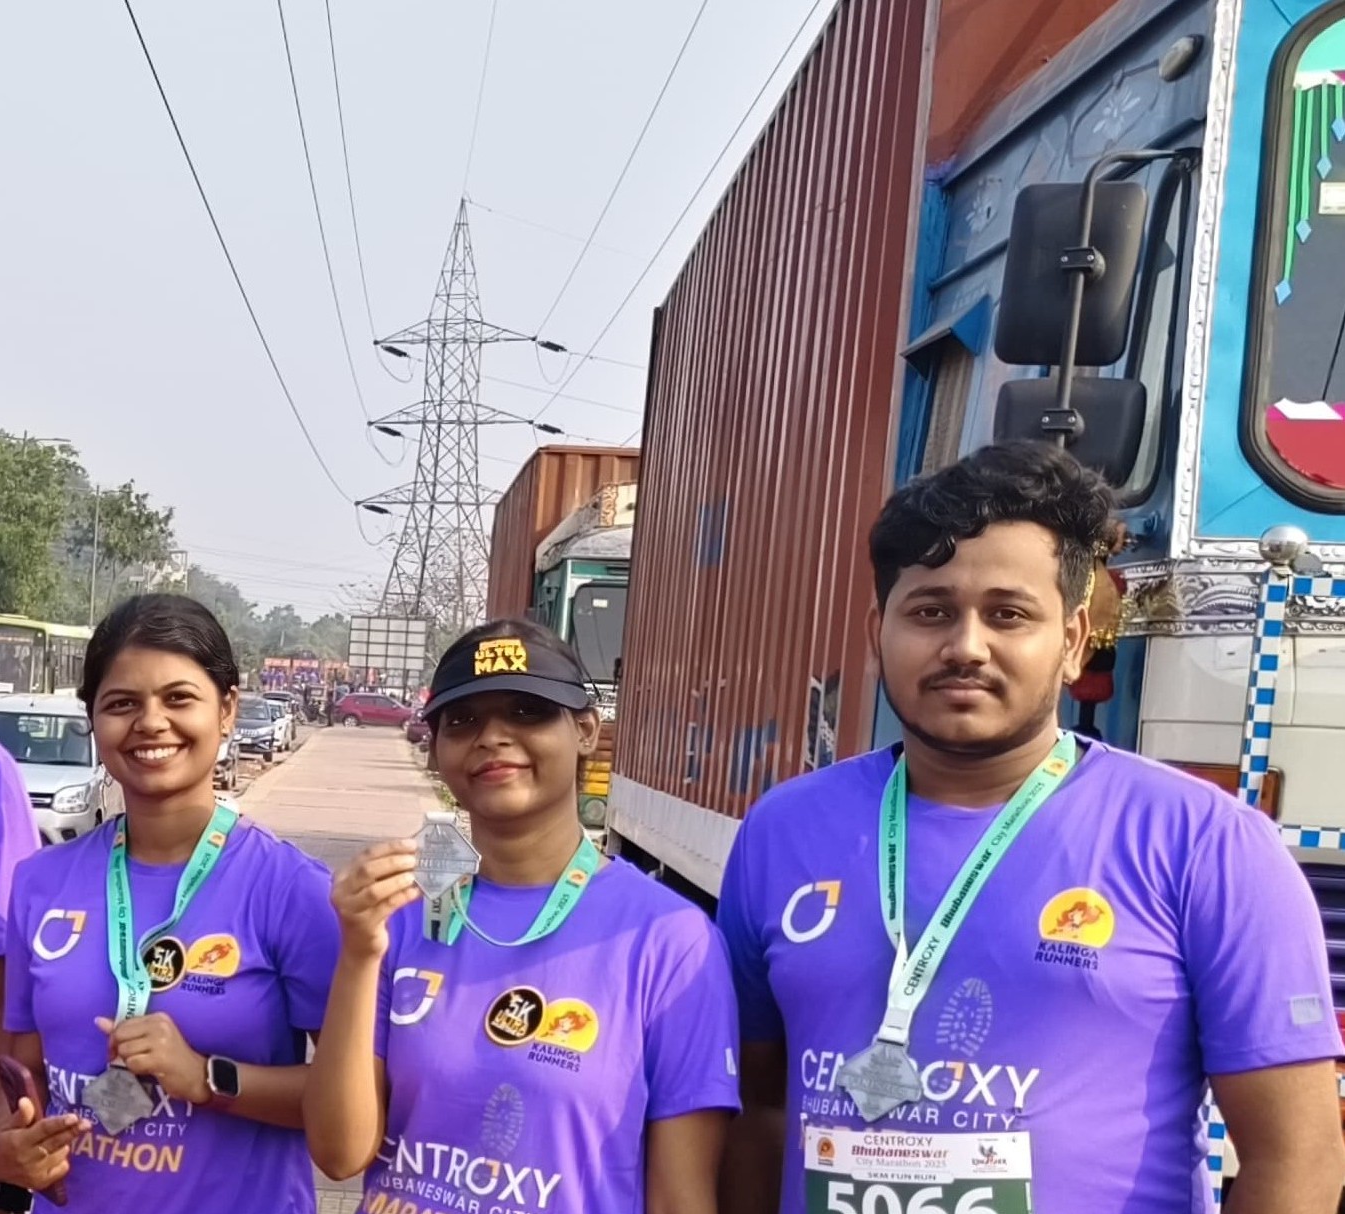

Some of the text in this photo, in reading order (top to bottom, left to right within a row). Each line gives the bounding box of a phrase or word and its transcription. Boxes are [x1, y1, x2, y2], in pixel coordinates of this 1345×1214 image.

[475, 656, 528, 675] MAX
[904, 936, 941, 996] CENTROXY
[940, 848, 992, 929] Bhubaneswar
[991, 830, 1007, 846] City
[1002, 796, 1032, 832] Marathon
[153, 949, 176, 967] 5K
[1034, 949, 1099, 970] RUNNERS
[1037, 940, 1100, 961] KALINGA
[181, 983, 226, 996] RUNNERS
[506, 997, 536, 1023] 5K
[527, 1051, 580, 1073] RUNNERS
[531, 1042, 582, 1063] KALINGA
[801, 1048, 1040, 1110] CEOXY
[802, 1095, 940, 1126] BHUBANWAR
[953, 1110, 1015, 1131] CITY
[144, 1123, 187, 1138] CITY
[863, 1135, 933, 1147] CENTROXY
[71, 1132, 184, 1173] ATHON
[851, 1145, 949, 1159] Bhubaneswar
[376, 1135, 562, 1210] NTROXY
[856, 1158, 872, 1167] City
[873, 1158, 922, 1168] Marathon
